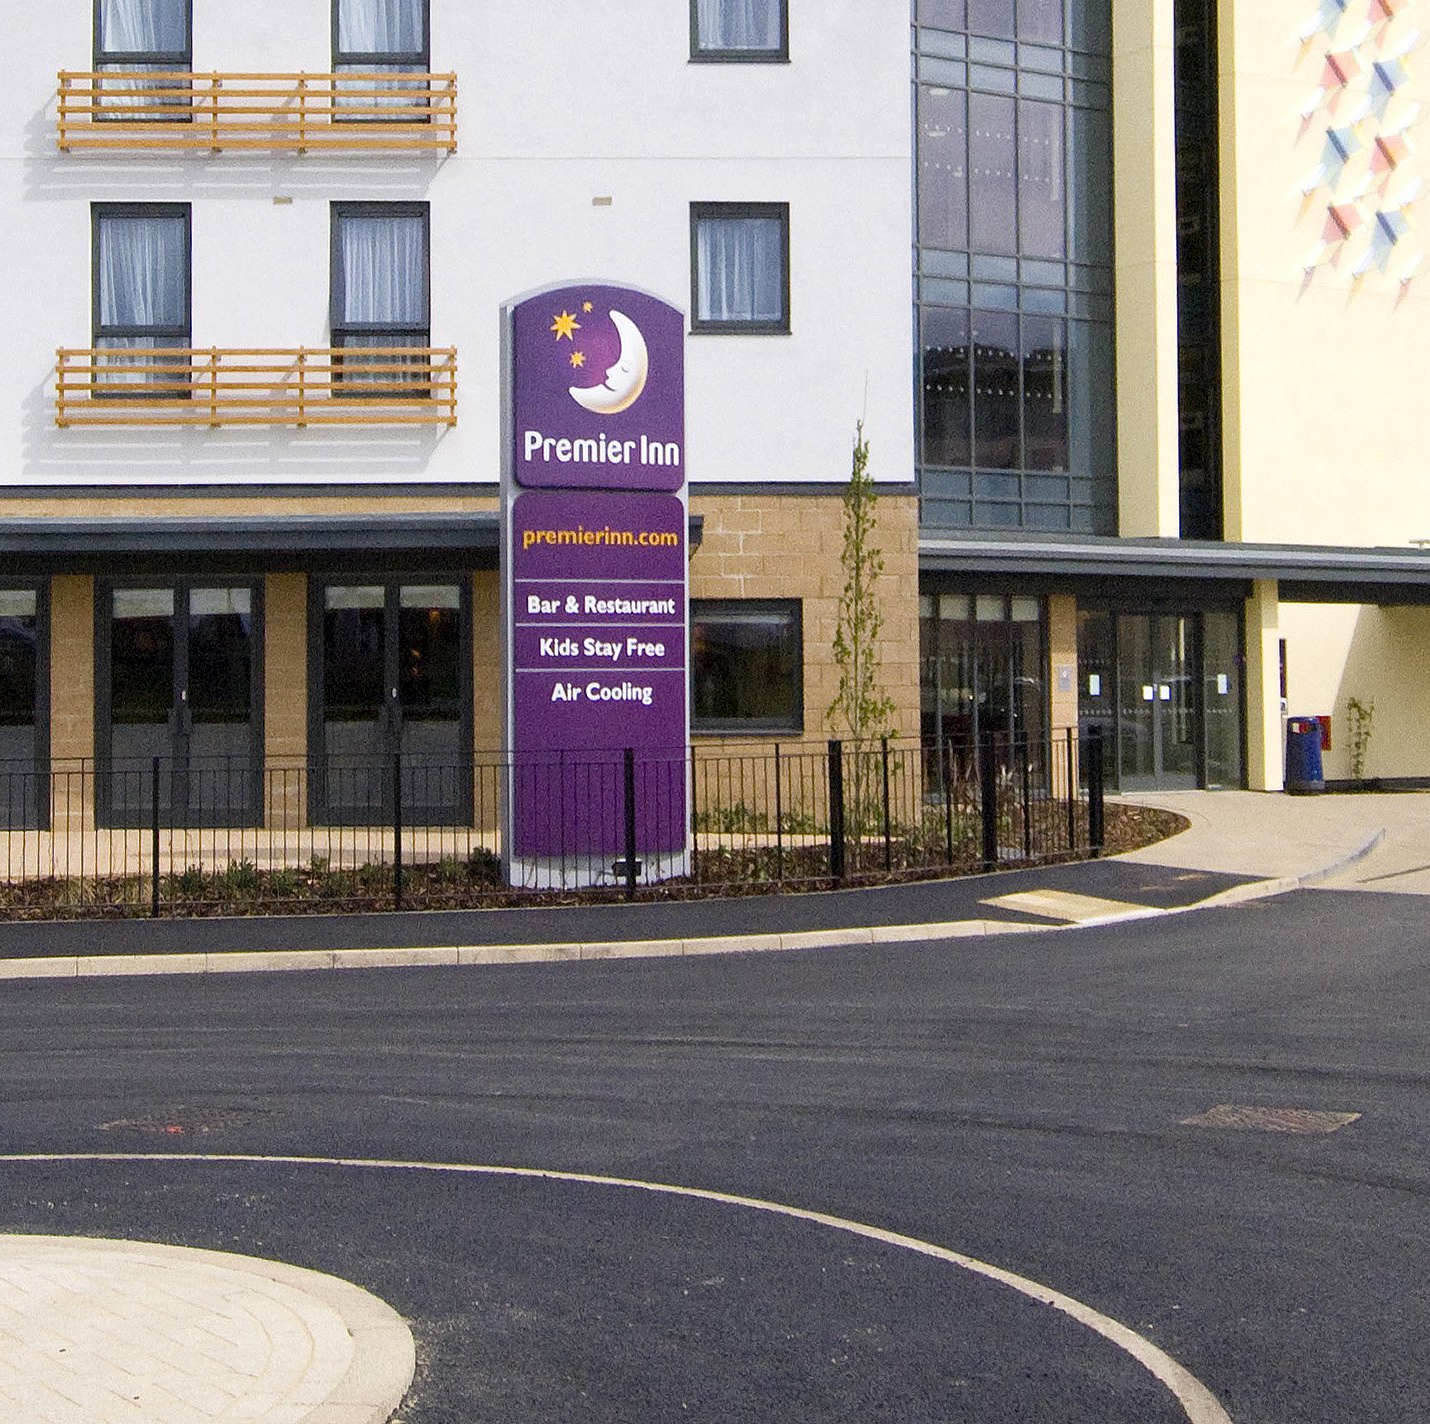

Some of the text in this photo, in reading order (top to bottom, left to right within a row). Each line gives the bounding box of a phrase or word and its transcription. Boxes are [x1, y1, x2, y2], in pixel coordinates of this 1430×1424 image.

[524, 430, 680, 466] Premier Inn
[523, 525, 678, 550] premierinn.com
[527, 595, 676, 616] Bar & Restaurant
[540, 637, 665, 662] Kids Stay Free
[551, 681, 653, 705] Air Cooling
